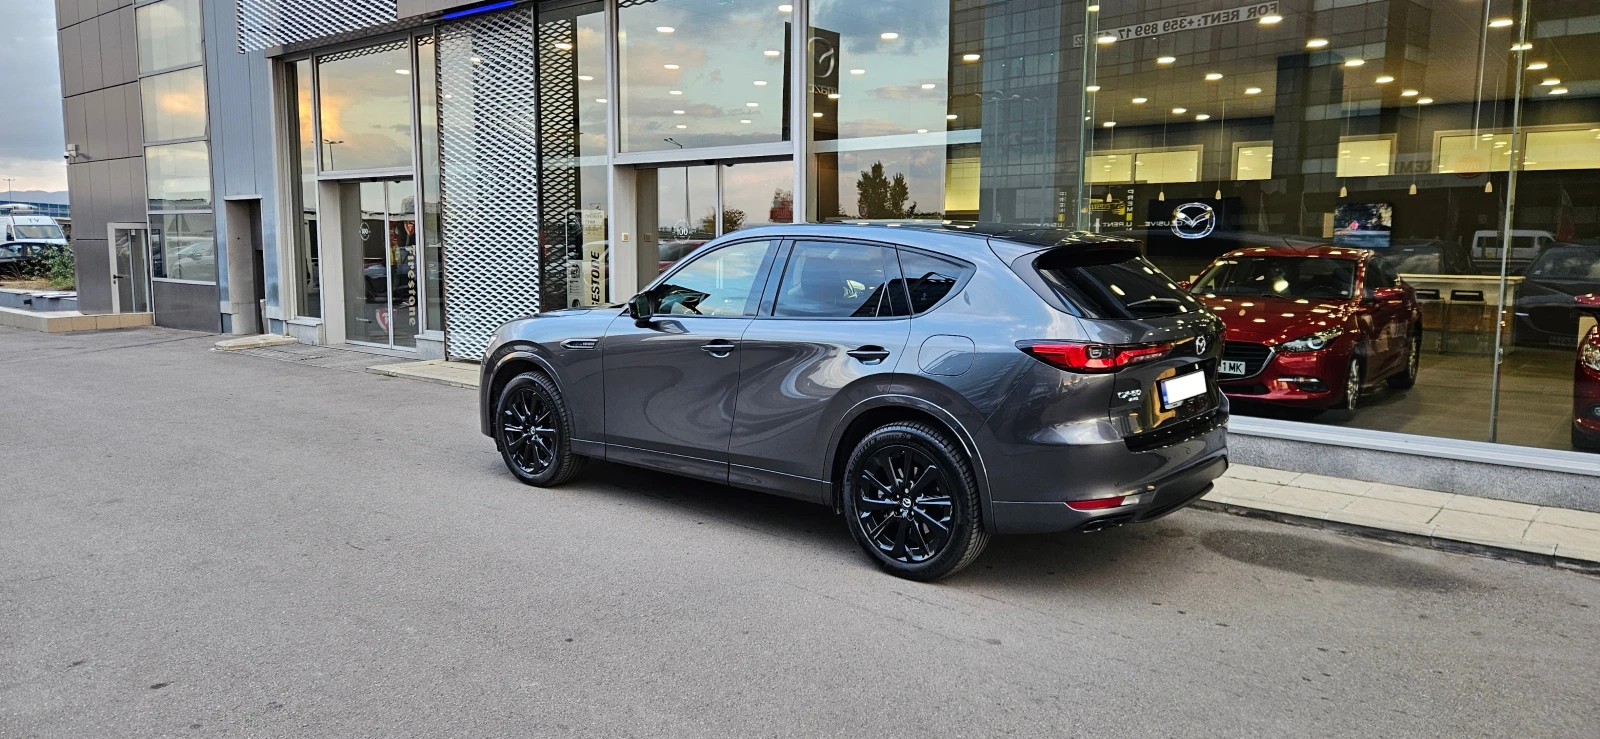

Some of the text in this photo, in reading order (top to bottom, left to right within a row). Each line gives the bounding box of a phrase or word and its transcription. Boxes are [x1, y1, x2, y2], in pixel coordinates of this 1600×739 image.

[405, 244, 417, 326] Firestone
[590, 250, 600, 305] ESTONE
[1228, 362, 1243, 374] MK
